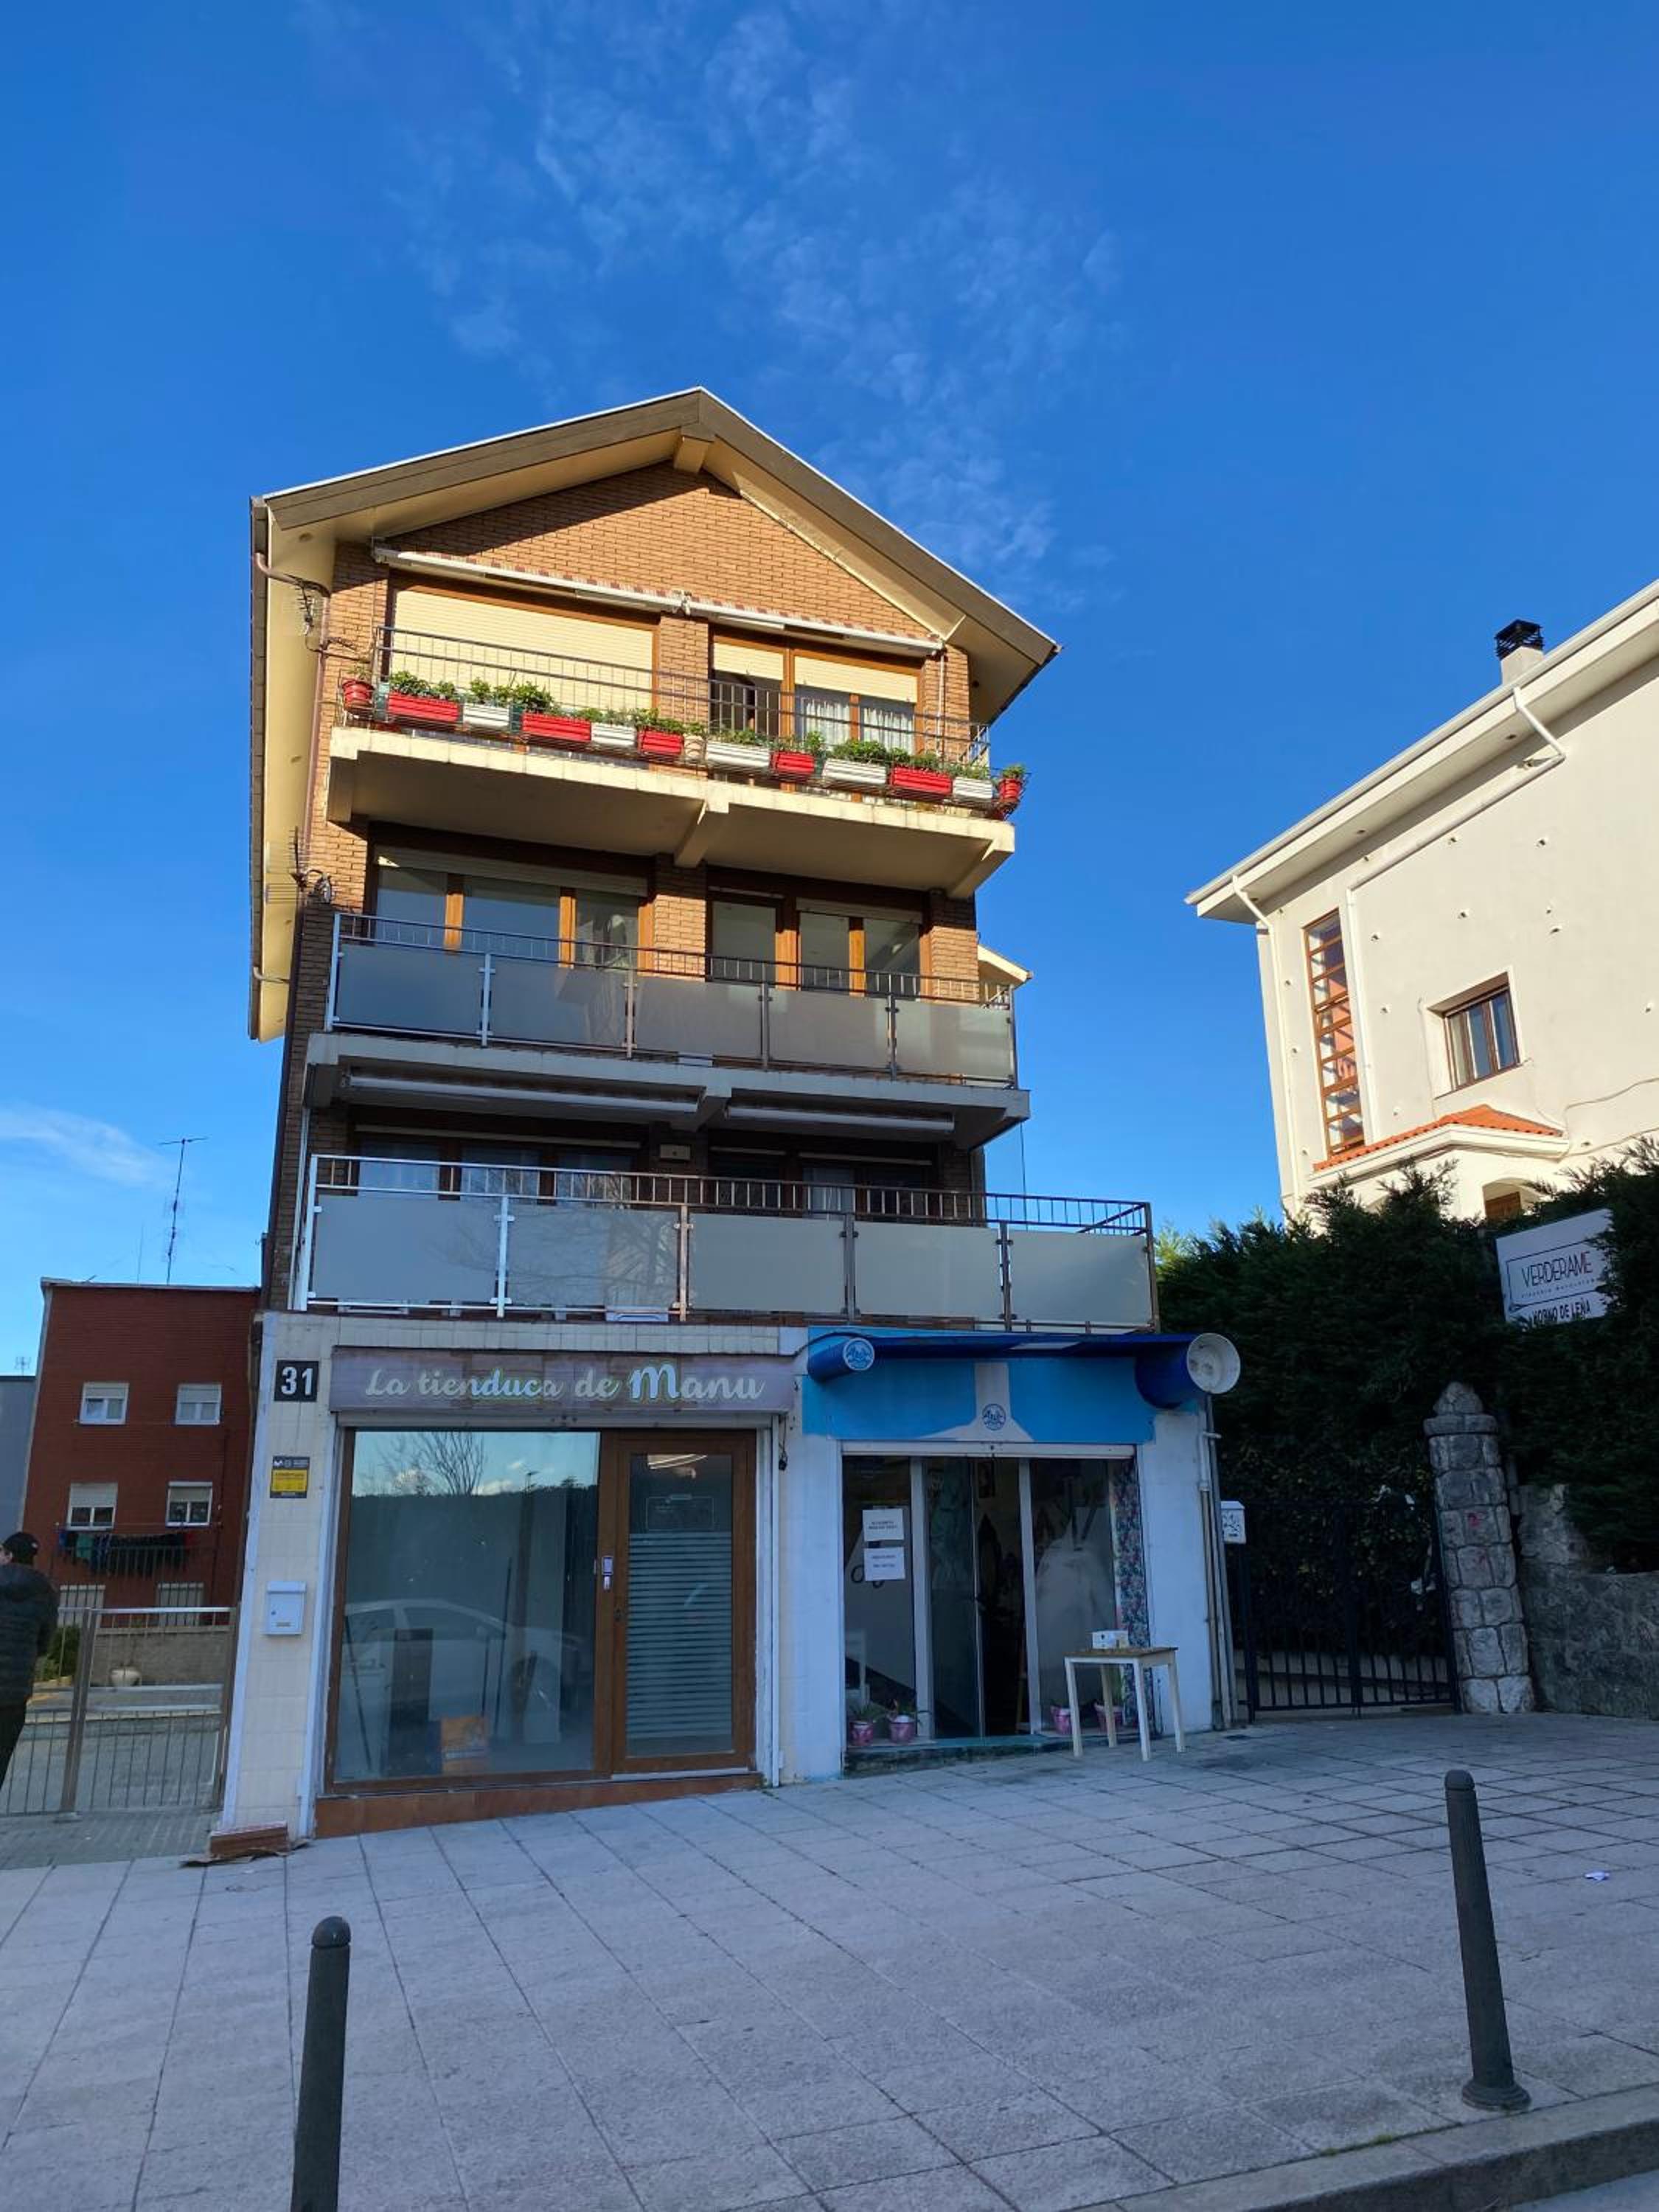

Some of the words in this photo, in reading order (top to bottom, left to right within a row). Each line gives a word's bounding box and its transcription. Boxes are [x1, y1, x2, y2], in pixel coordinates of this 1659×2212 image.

[1521, 1251, 1593, 1288] VERDERAME
[1559, 1304, 1570, 1319] DE
[281, 1366, 313, 1396] 31
[365, 1368, 411, 1397] La
[417, 1368, 566, 1398] tienduca
[574, 1368, 621, 1399] de
[629, 1363, 766, 1399] Manu
